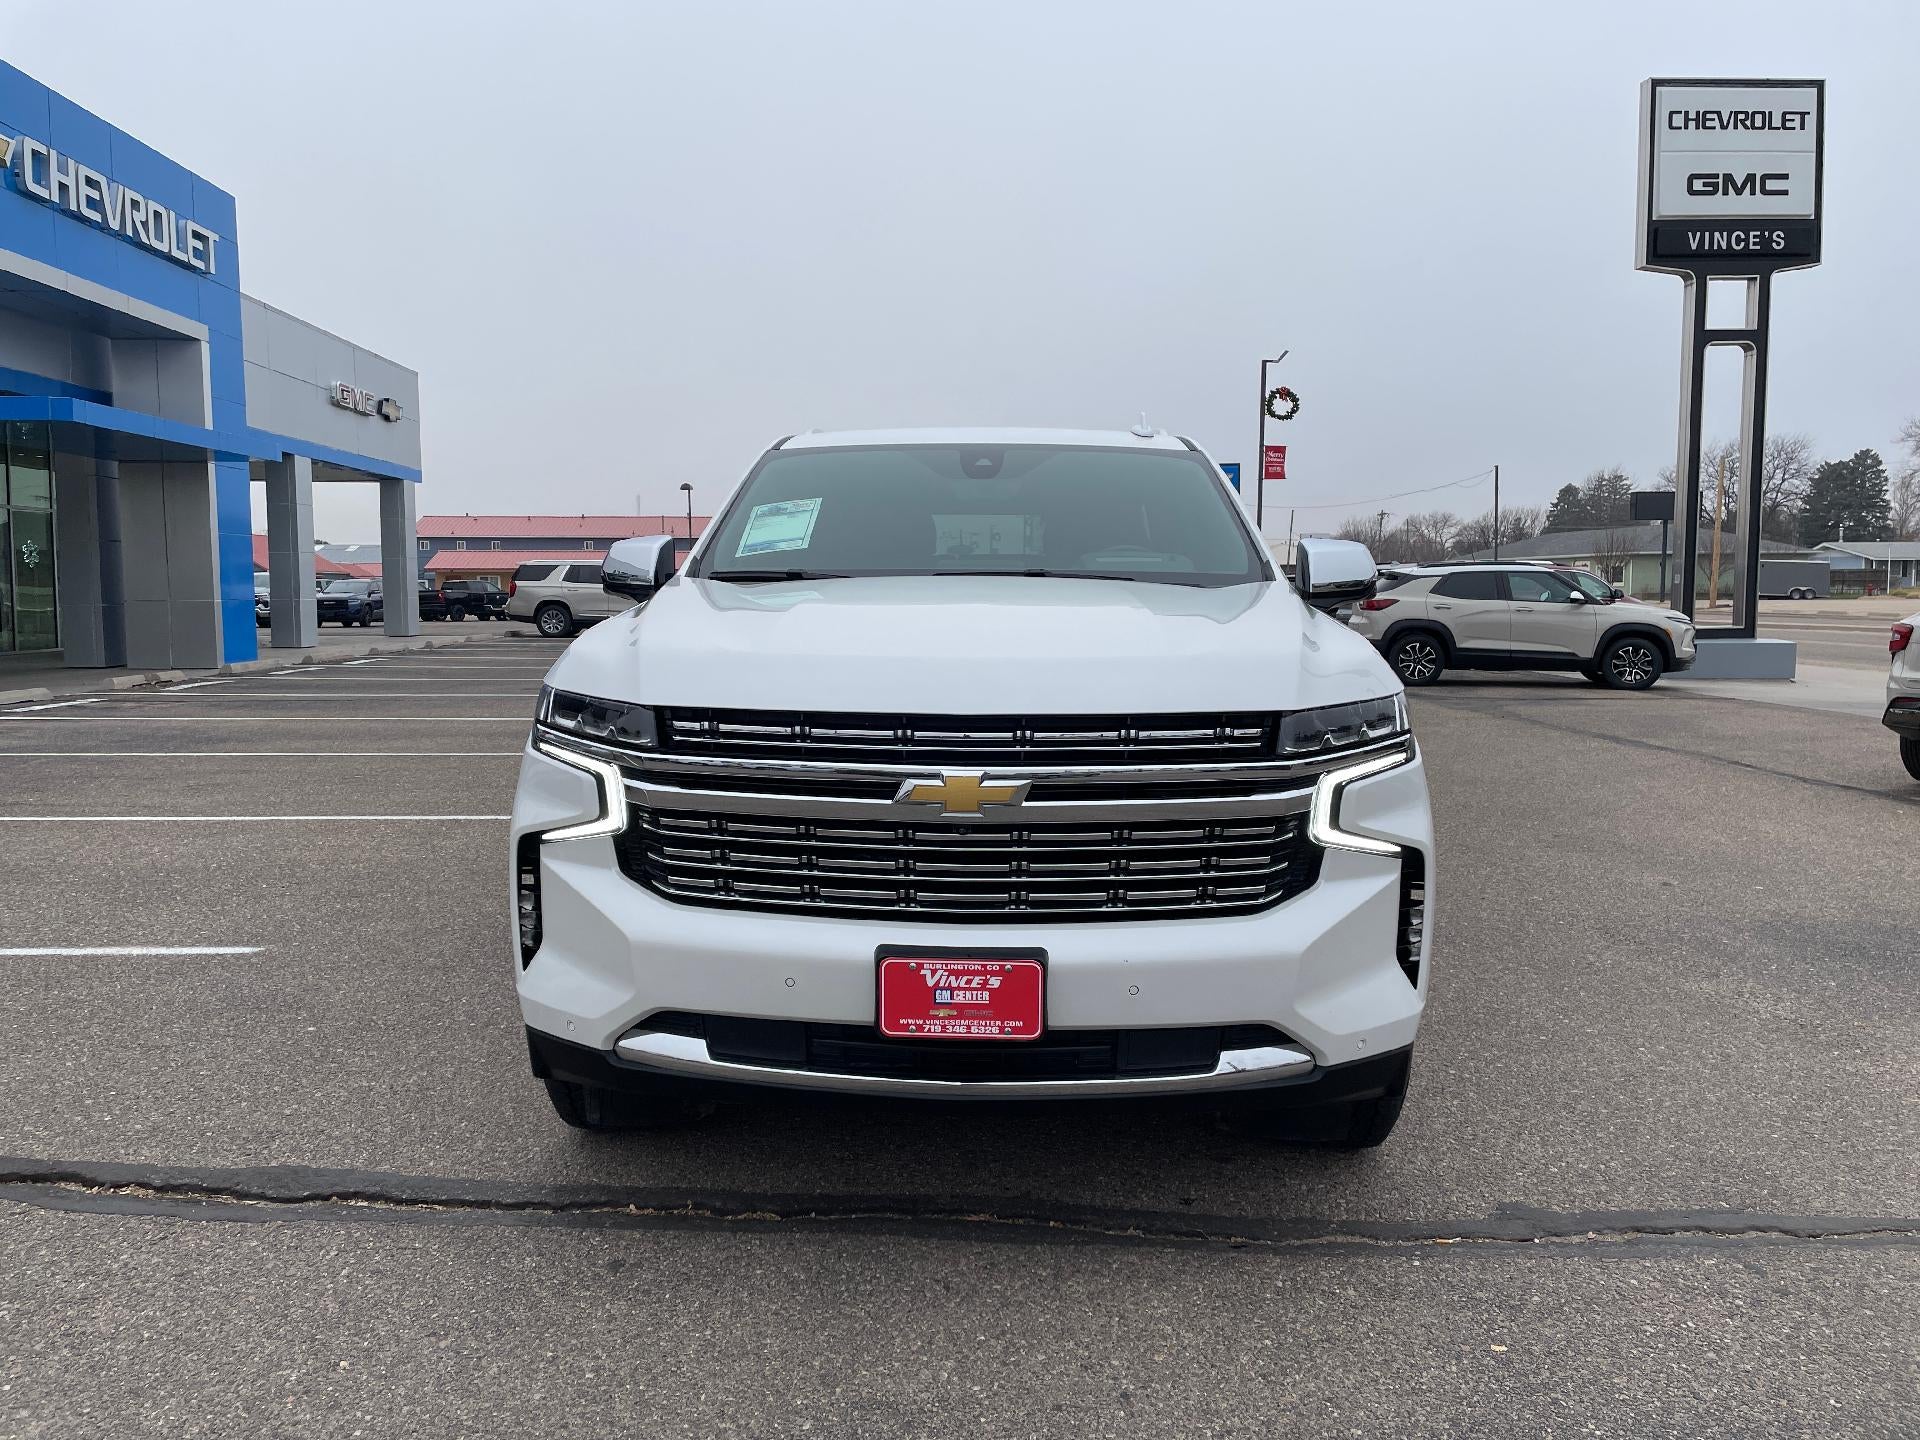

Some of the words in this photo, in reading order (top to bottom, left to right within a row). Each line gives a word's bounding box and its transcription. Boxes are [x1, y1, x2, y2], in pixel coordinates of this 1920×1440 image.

[1668, 110, 1811, 131] CHEVROLET
[1686, 172, 1790, 196] GMC
[20, 136, 219, 275] CHEVROLET
[1687, 230, 1785, 250] VINCE'S
[333, 381, 375, 416] GMC
[935, 990, 951, 1001] GM
[953, 990, 990, 1001] CENTER
